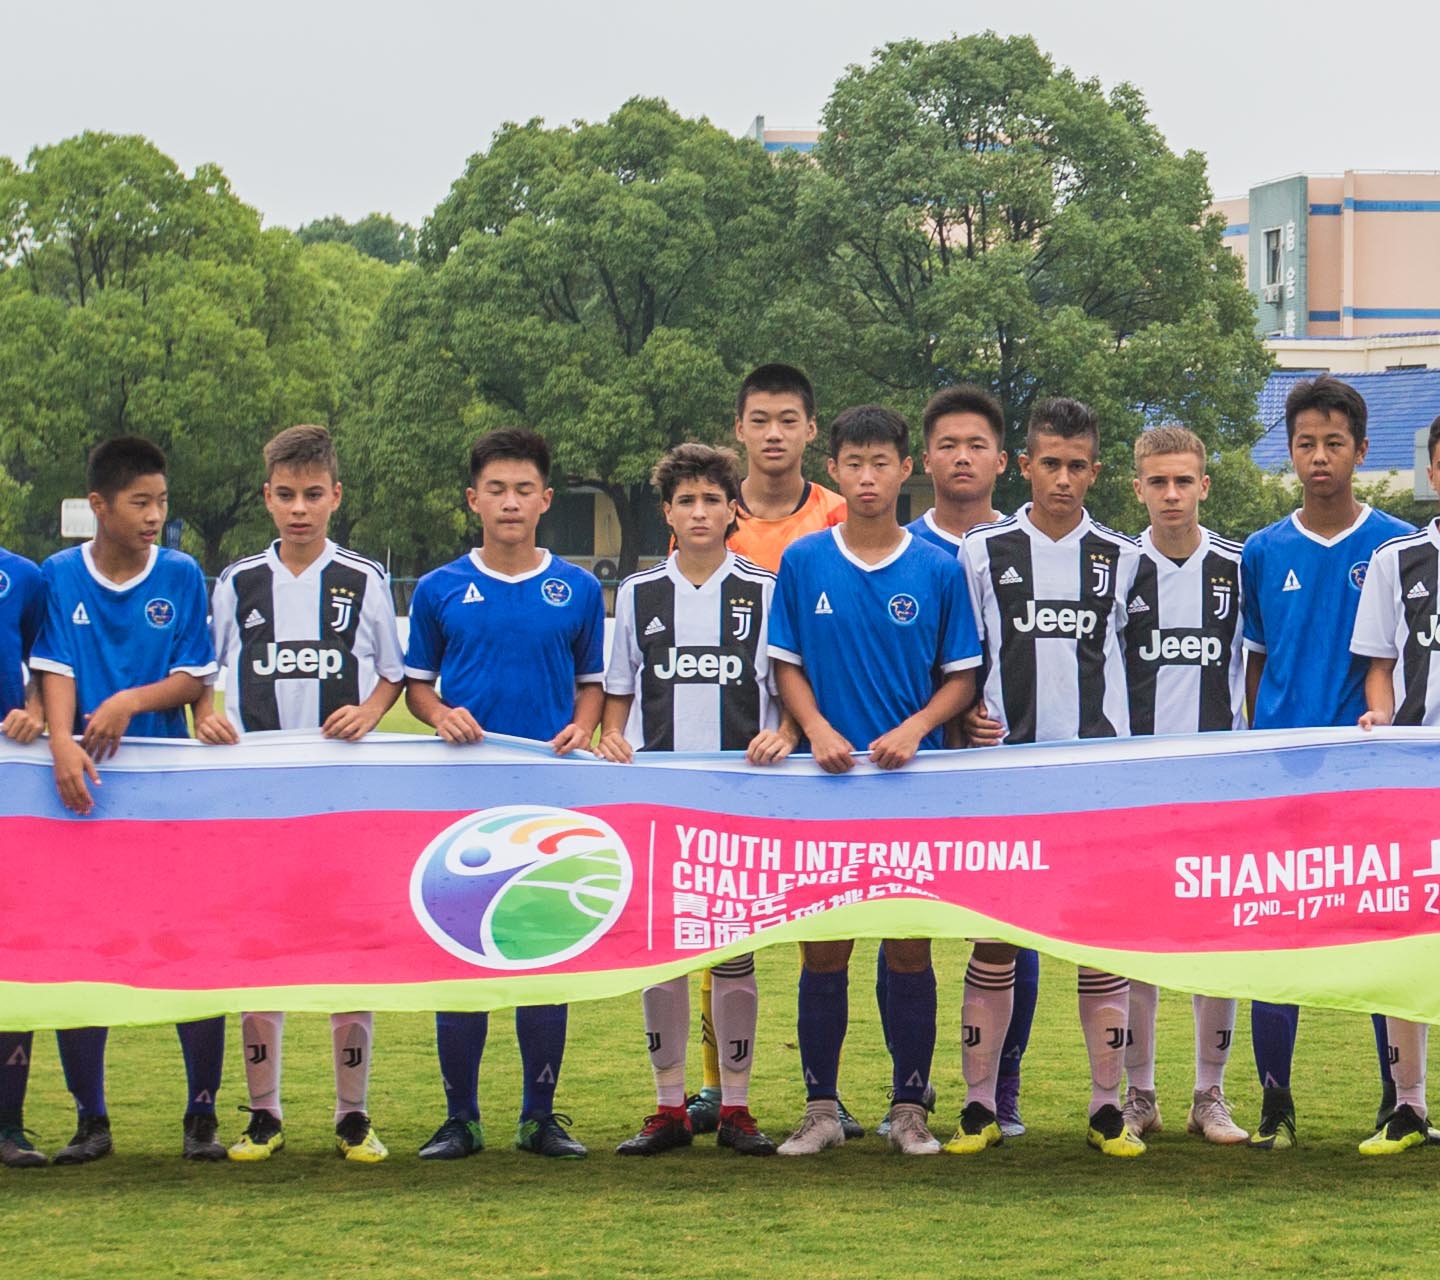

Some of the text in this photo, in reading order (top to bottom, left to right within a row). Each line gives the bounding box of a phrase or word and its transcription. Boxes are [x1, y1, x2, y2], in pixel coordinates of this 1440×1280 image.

[1012, 600, 1098, 639] Jeep
[252, 642, 343, 680] Jeep
[653, 647, 743, 685] Jeep
[1138, 629, 1222, 666] Jeep
[674, 824, 1050, 873] YOUTH INTERNATIONAL
[672, 861, 859, 900] CHALLENGE
[1175, 842, 1400, 898] SHANGHAI
[673, 891, 787, 921] 青少年
[1233, 892, 1345, 927] 12ND-17TH
[1357, 886, 1410, 914] AUG
